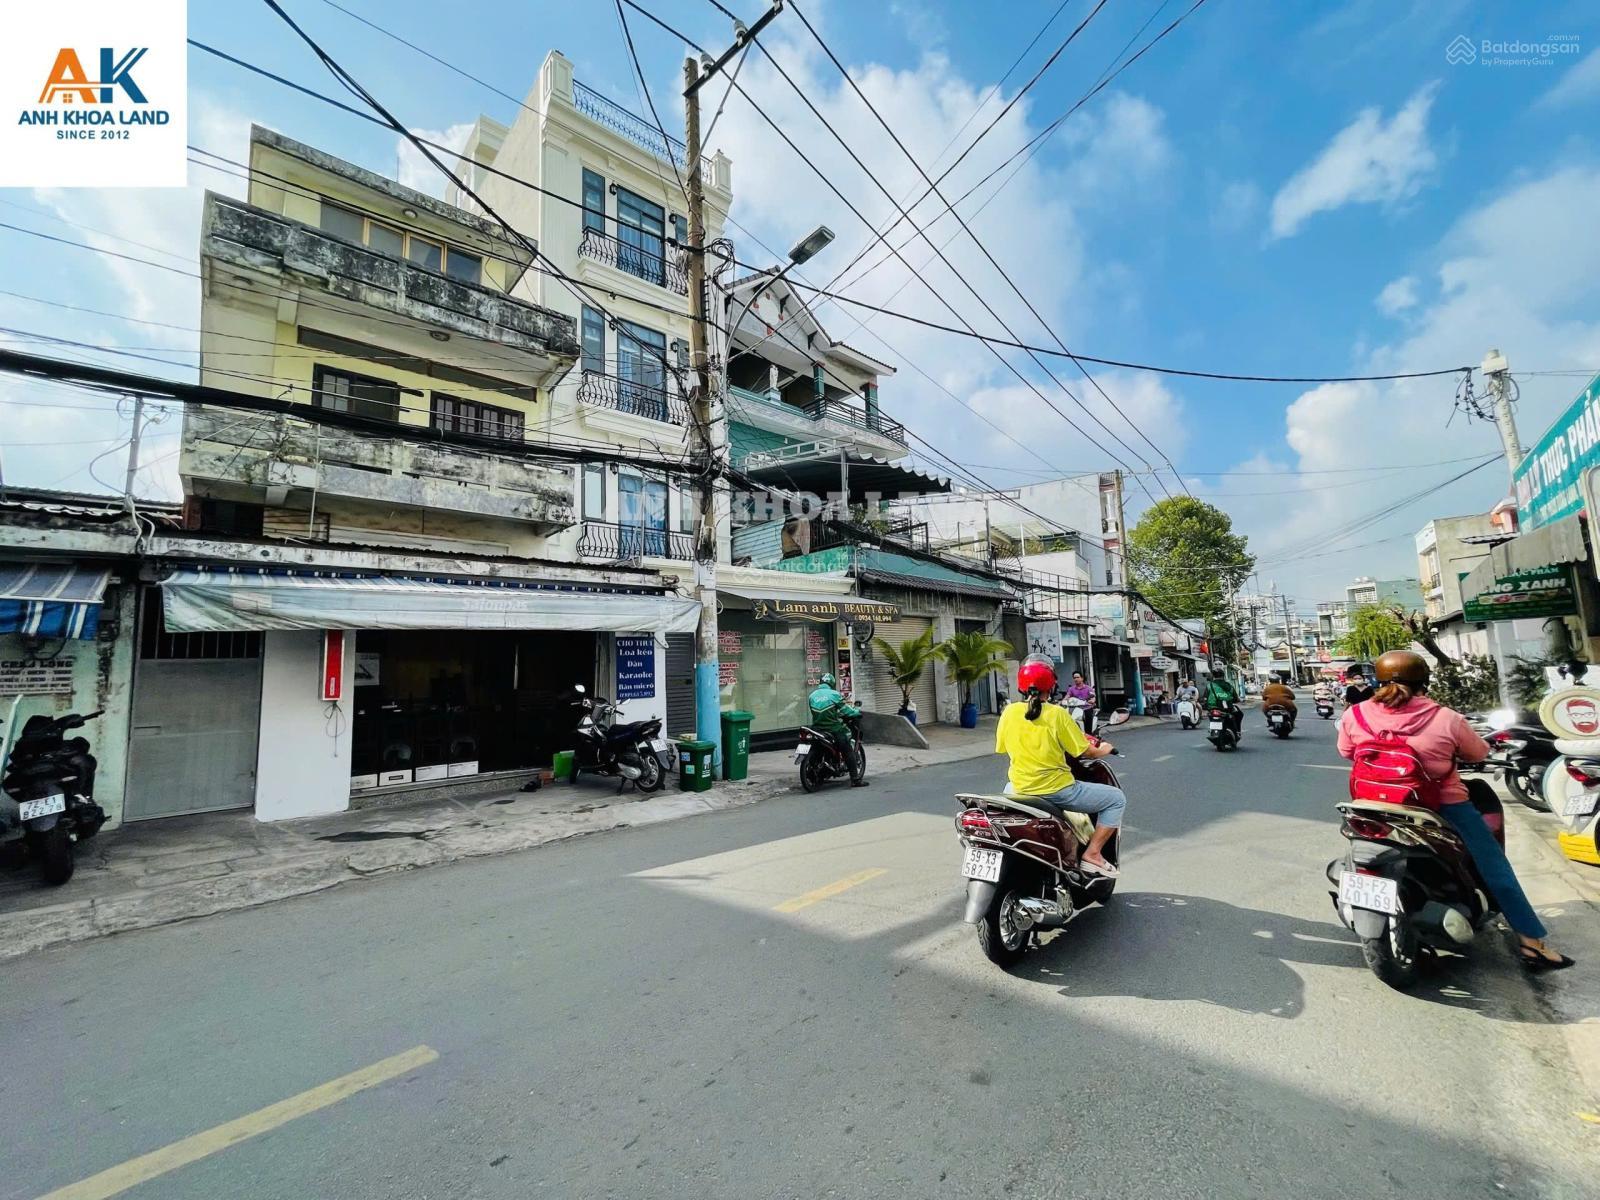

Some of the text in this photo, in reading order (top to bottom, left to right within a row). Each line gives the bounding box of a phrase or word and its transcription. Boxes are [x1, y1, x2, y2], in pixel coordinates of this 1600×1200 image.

[1540, 436, 1568, 485] THỰC
[1517, 578, 1566, 591] XANH
[812, 602, 838, 614] anh
[844, 604, 899, 614] BEAUTY & SPA
[619, 648, 635, 656] Loa
[619, 671, 653, 679] Karaoke
[1349, 875, 1388, 894] 59-F2
